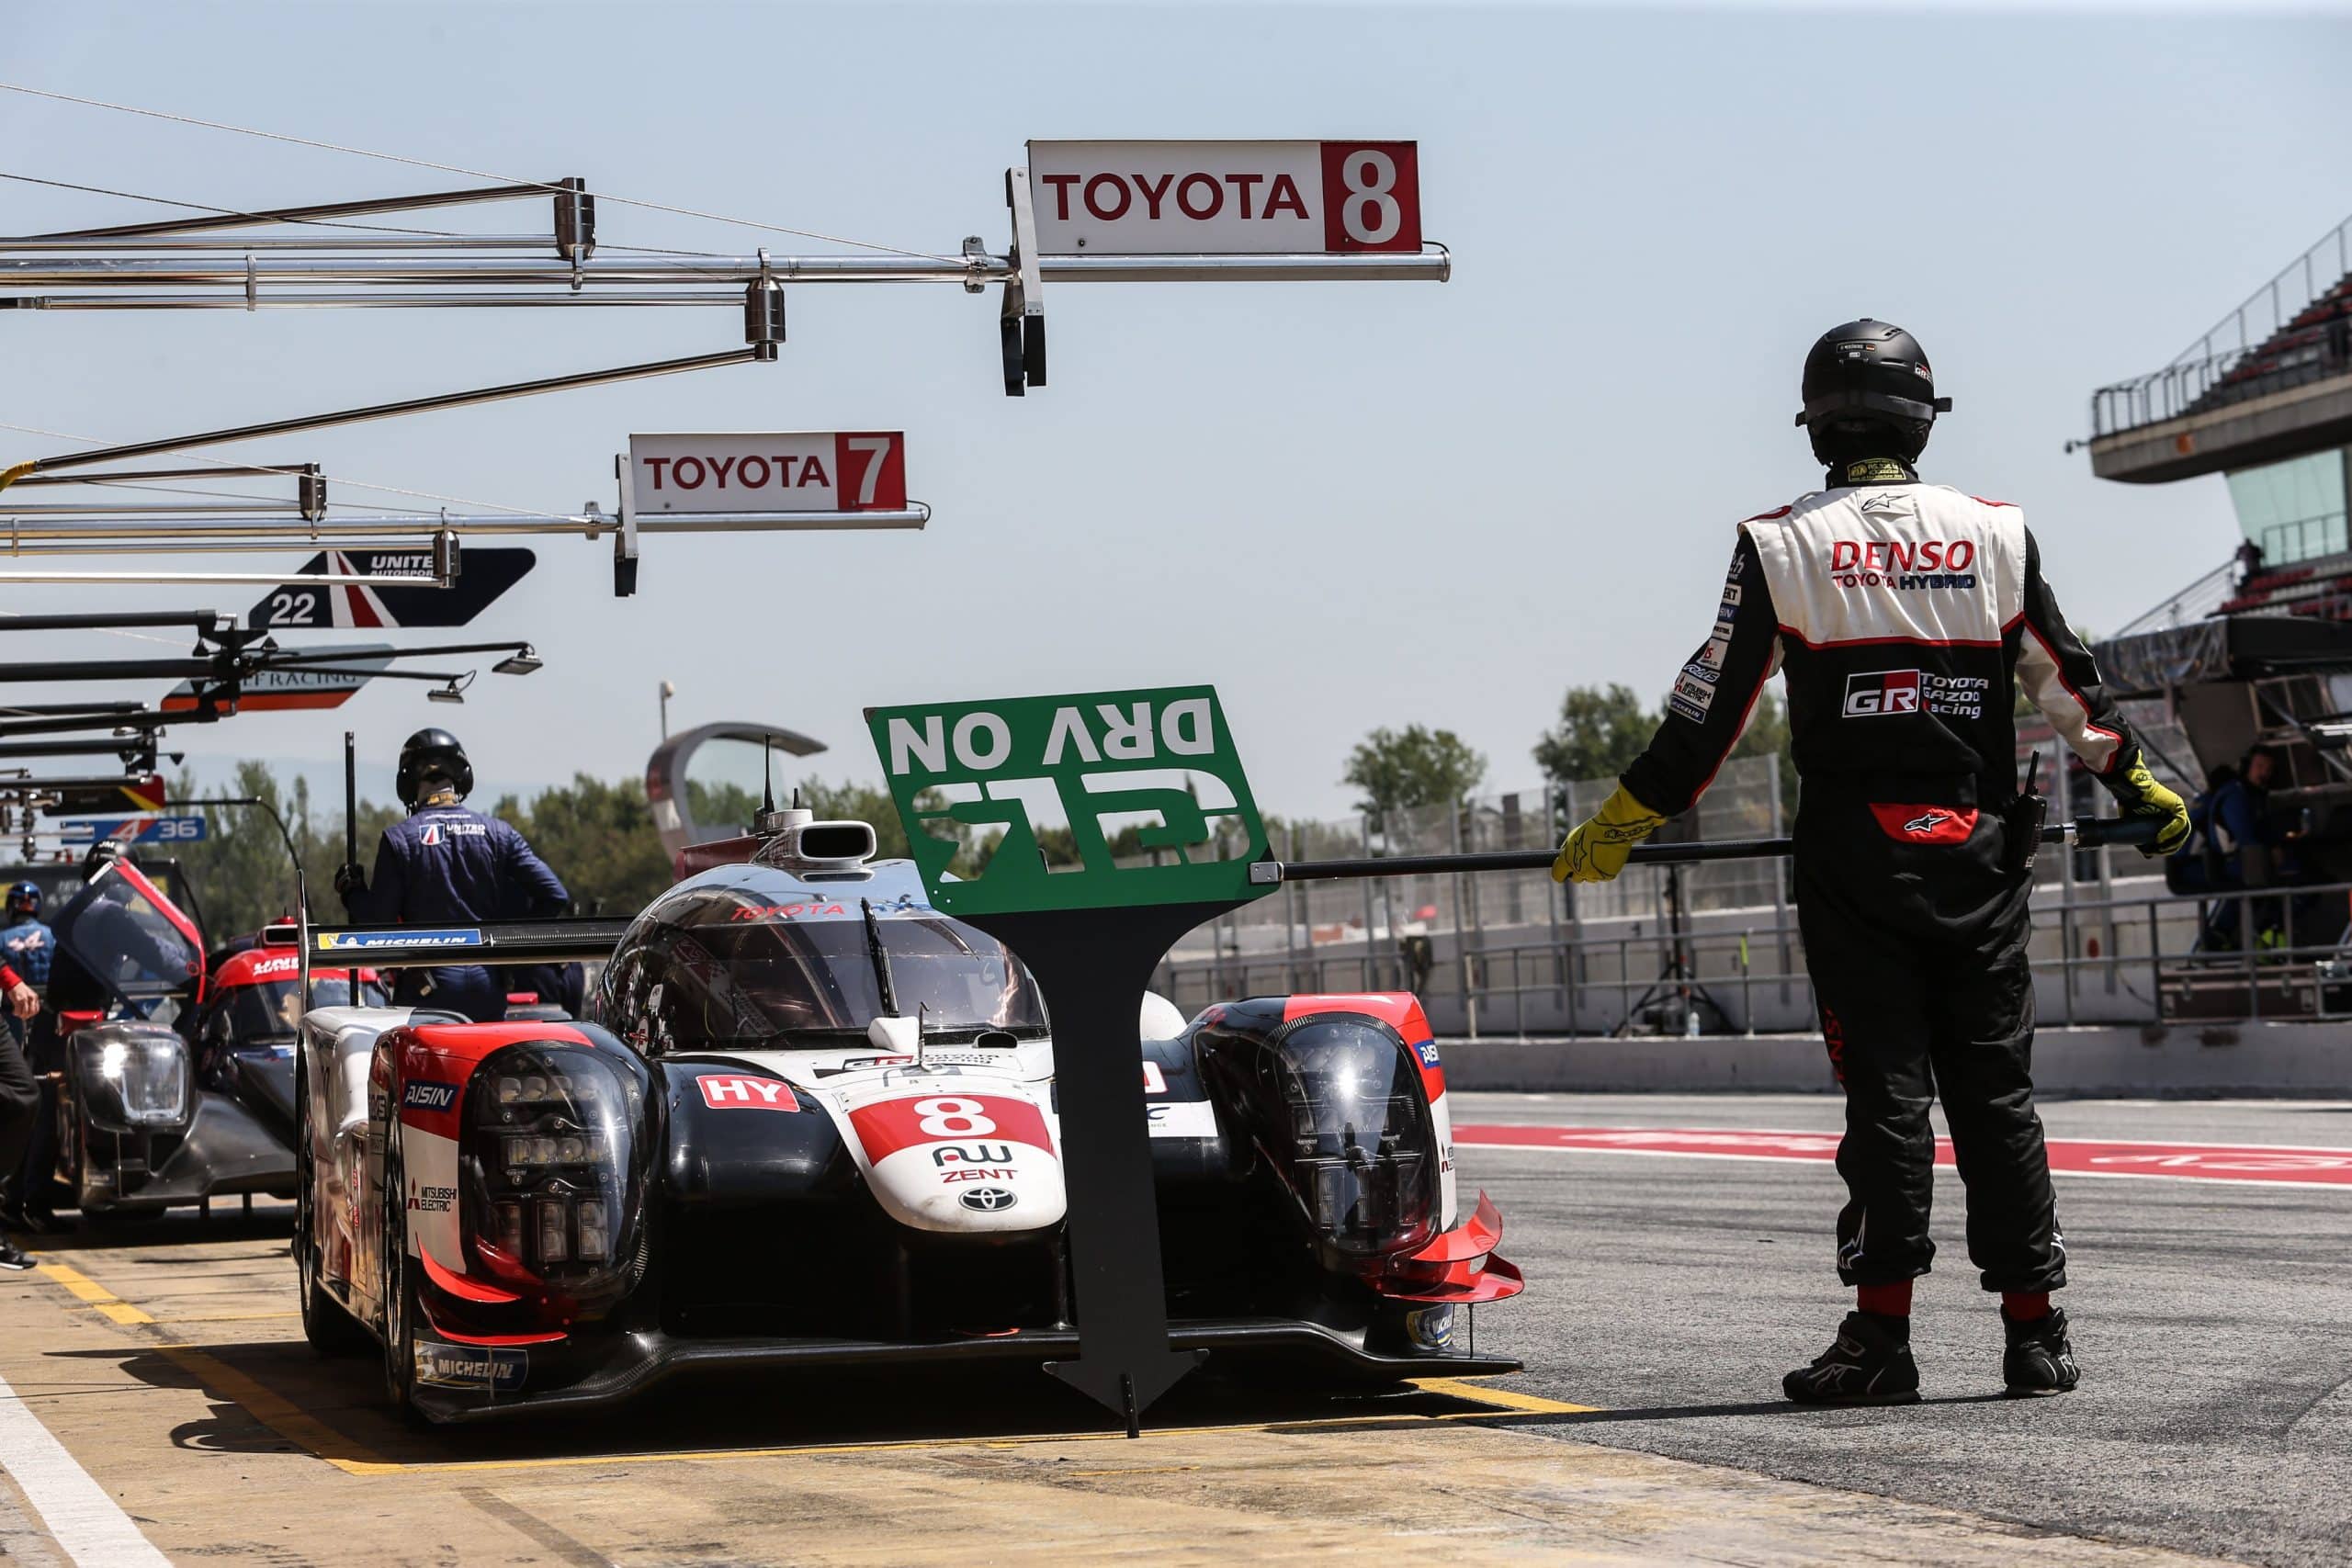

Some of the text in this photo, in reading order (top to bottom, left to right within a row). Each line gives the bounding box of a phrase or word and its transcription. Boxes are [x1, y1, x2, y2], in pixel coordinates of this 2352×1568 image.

[1042, 149, 1402, 244] TOYOTA 8
[643, 437, 890, 504] TOYOTA 7
[370, 556, 434, 570] UNITE
[1831, 540, 1974, 572] DENSO
[1833, 572, 1976, 590] TOYOTA HYBRID
[269, 592, 315, 625] 22
[1920, 672, 1989, 690] TOYOTA
[1847, 686, 1917, 714] GR
[1923, 687, 1981, 703] GAZOO
[888, 698, 1215, 775] DRV ON
[158, 820, 198, 839] 36
[730, 904, 827, 920] TOYOTA
[366, 937, 467, 946] MICHELIN
[405, 1085, 454, 1108] AISIN
[706, 1079, 783, 1102] HY
[913, 1097, 997, 1138] 8
[940, 1168, 1018, 1183] ZENT
[421, 1186, 457, 1201] MITSUBISHI
[421, 1199, 451, 1213] ELECTRIC
[438, 1359, 514, 1379] MICHELIN
